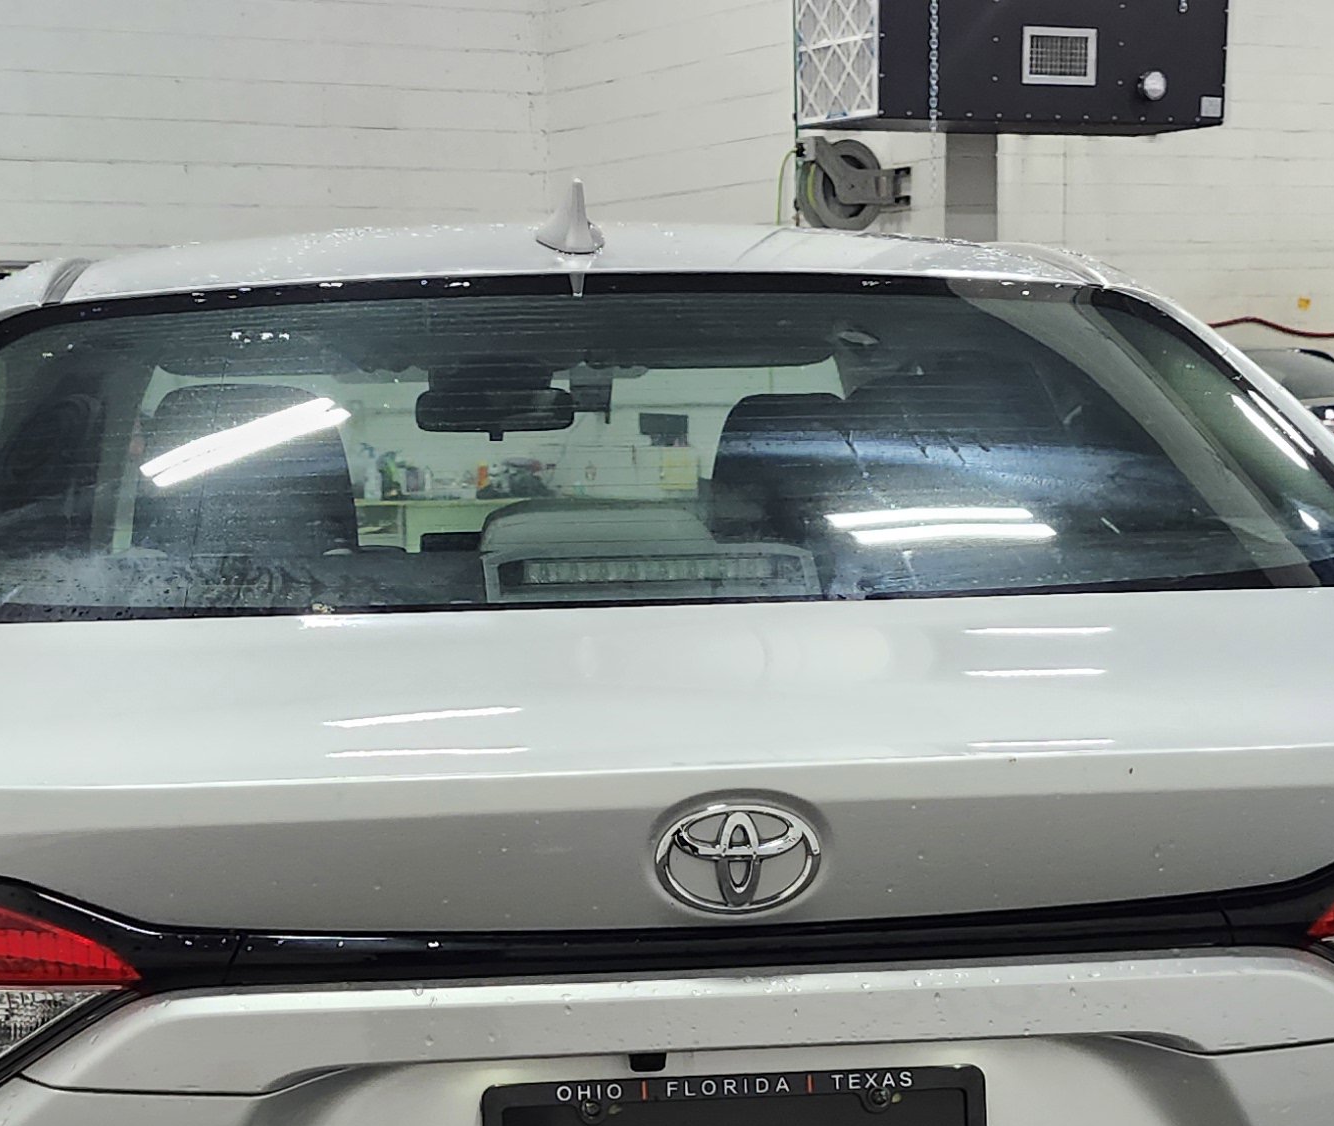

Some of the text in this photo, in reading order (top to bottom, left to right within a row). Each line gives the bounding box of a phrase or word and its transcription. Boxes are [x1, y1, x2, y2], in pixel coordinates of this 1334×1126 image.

[556, 1071, 913, 1101] OHIO FLORIDA TEXAS
